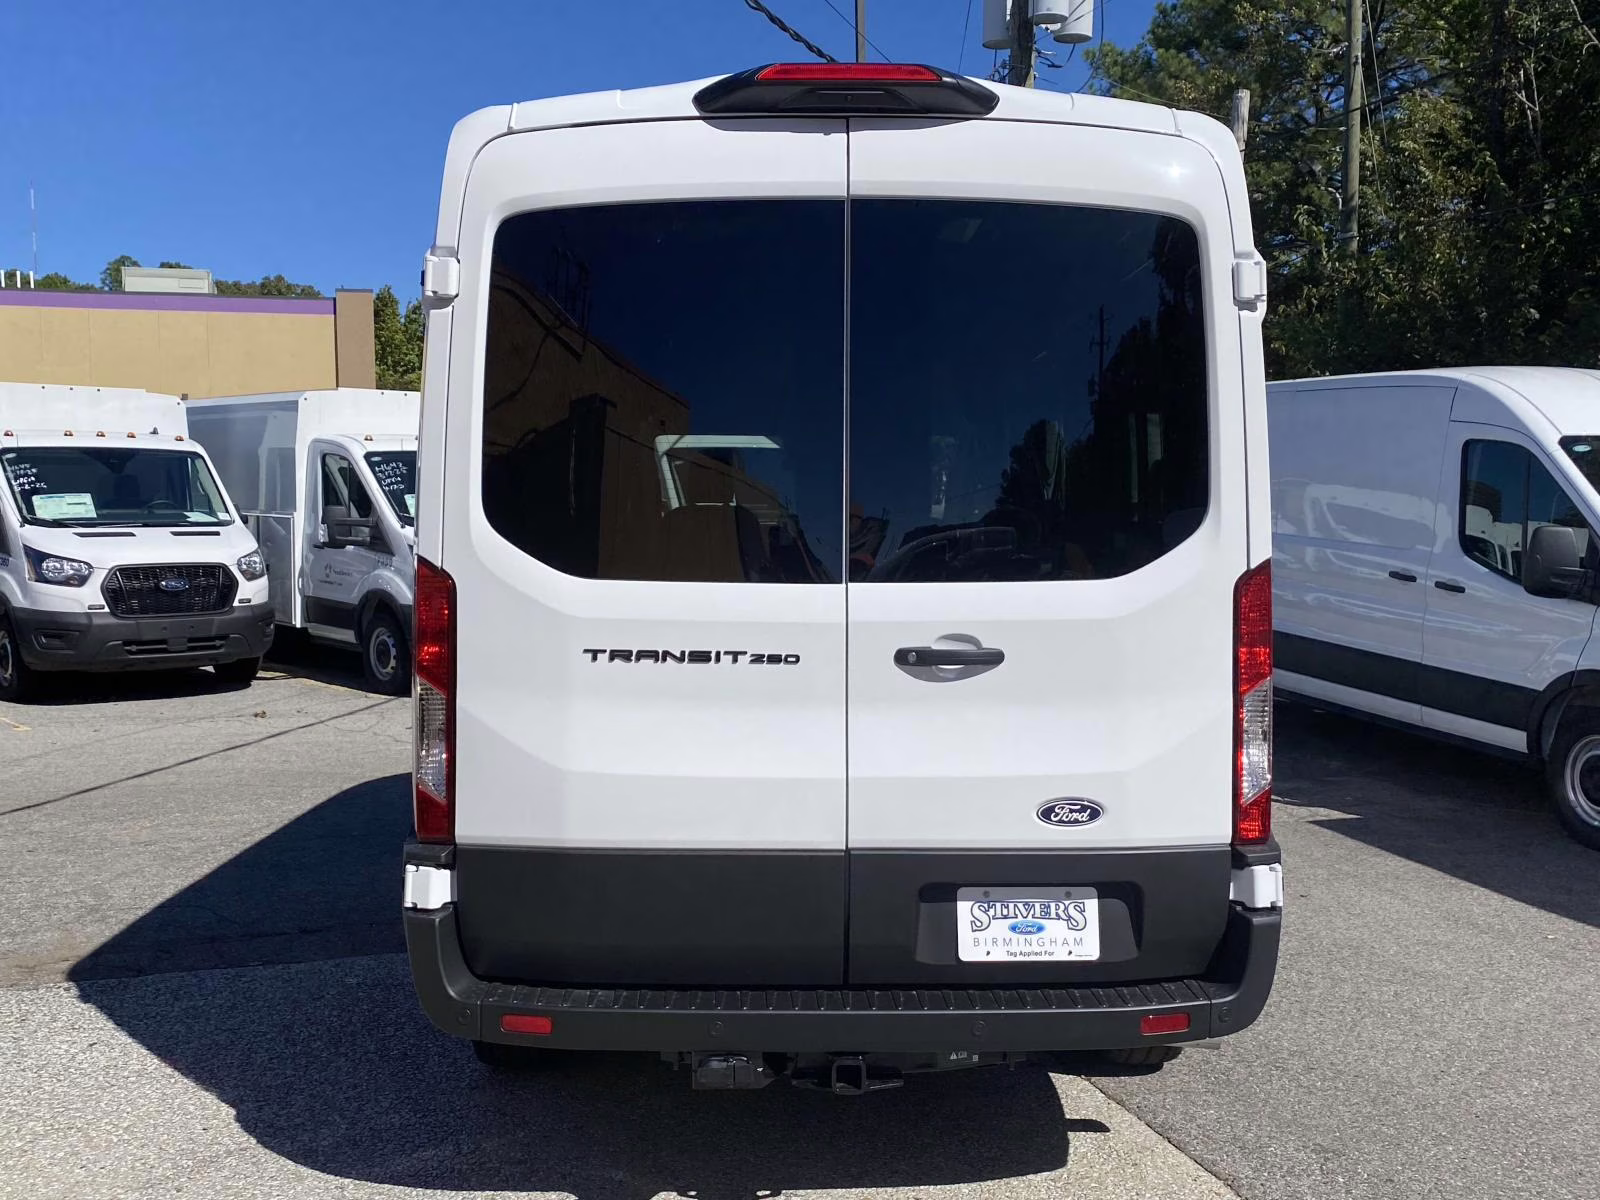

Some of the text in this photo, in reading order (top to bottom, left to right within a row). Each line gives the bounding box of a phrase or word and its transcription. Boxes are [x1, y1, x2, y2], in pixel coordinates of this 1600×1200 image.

[582, 648, 801, 665] TRANSIT 250
[1050, 804, 1091, 822] Ford
[970, 900, 1087, 932] STIVERS
[1015, 922, 1038, 933] Ford
[973, 937, 1084, 948] BIRMINGHAM
[1006, 949, 1055, 958] Tag Applied For
